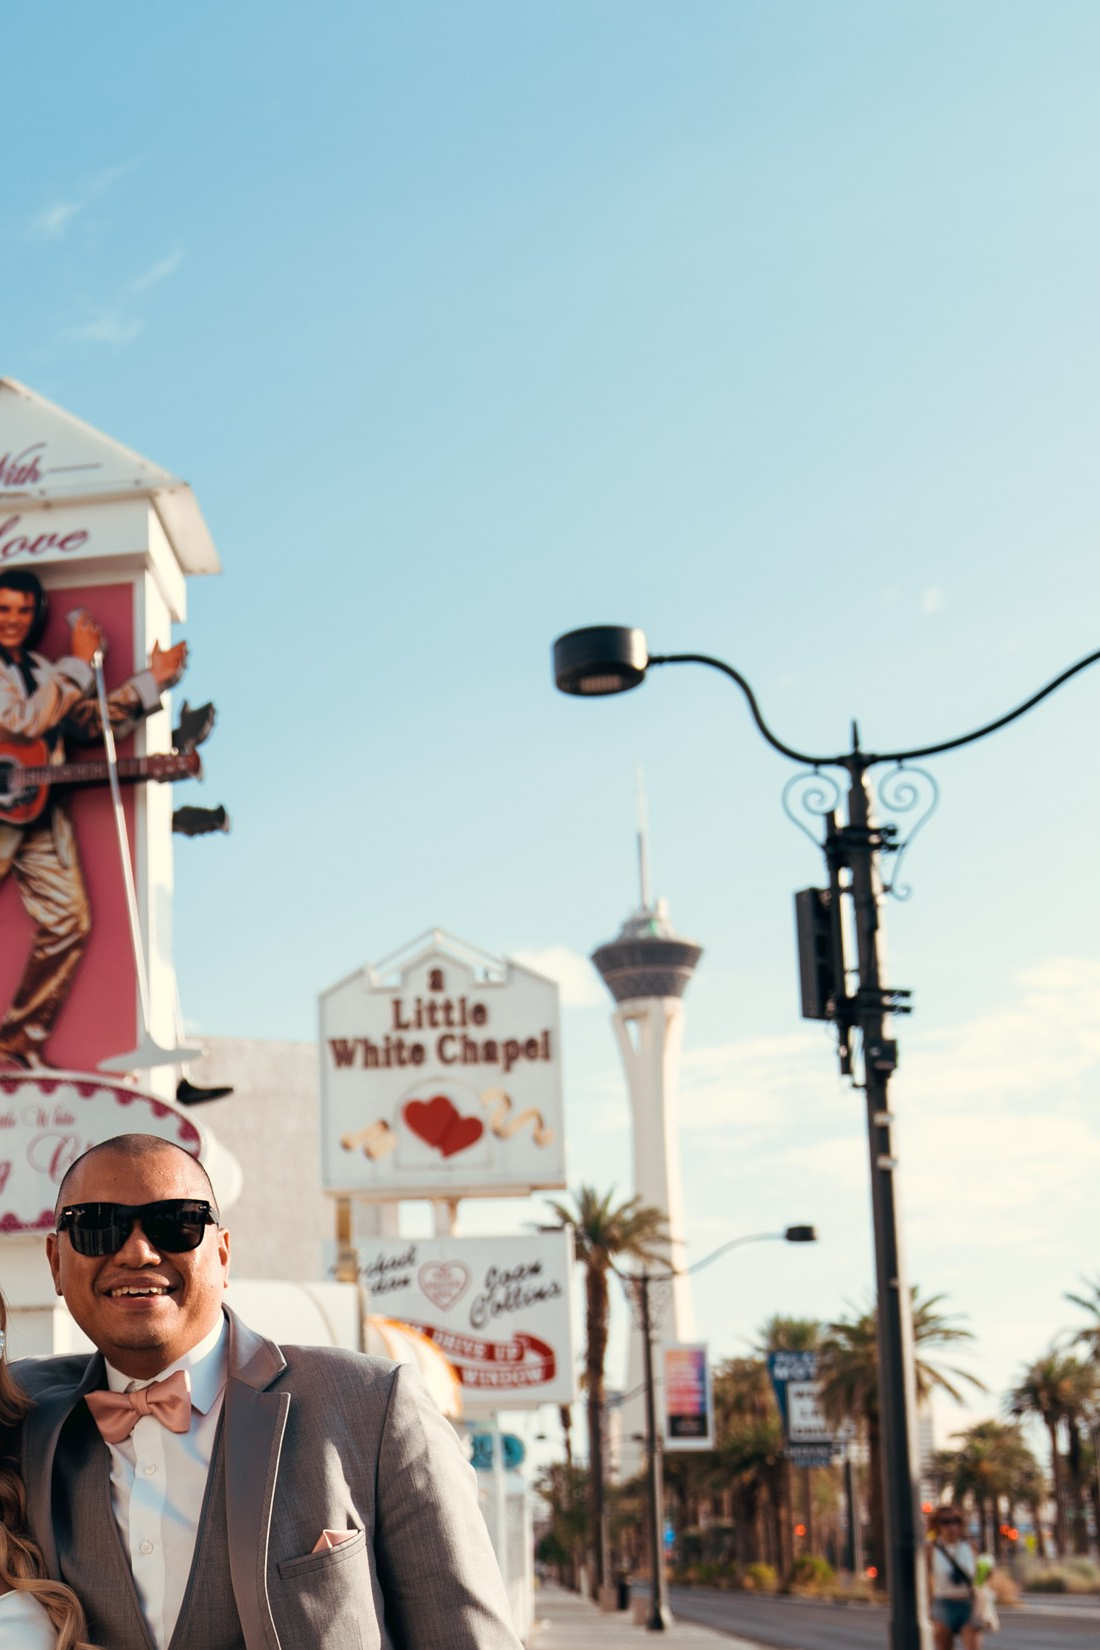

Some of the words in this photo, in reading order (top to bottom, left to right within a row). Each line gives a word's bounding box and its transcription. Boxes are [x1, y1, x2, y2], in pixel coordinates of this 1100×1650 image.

[428, 968, 444, 992] a
[391, 997, 488, 1031] Little
[328, 1034, 426, 1070] White
[436, 1030, 552, 1073] Chapel
[20, 1103, 76, 1128] White
[469, 1280, 563, 1331] Collins
[433, 1331, 486, 1358] DRIVE
[494, 1343, 522, 1361] UP
[462, 1366, 544, 1386] WINDOW
